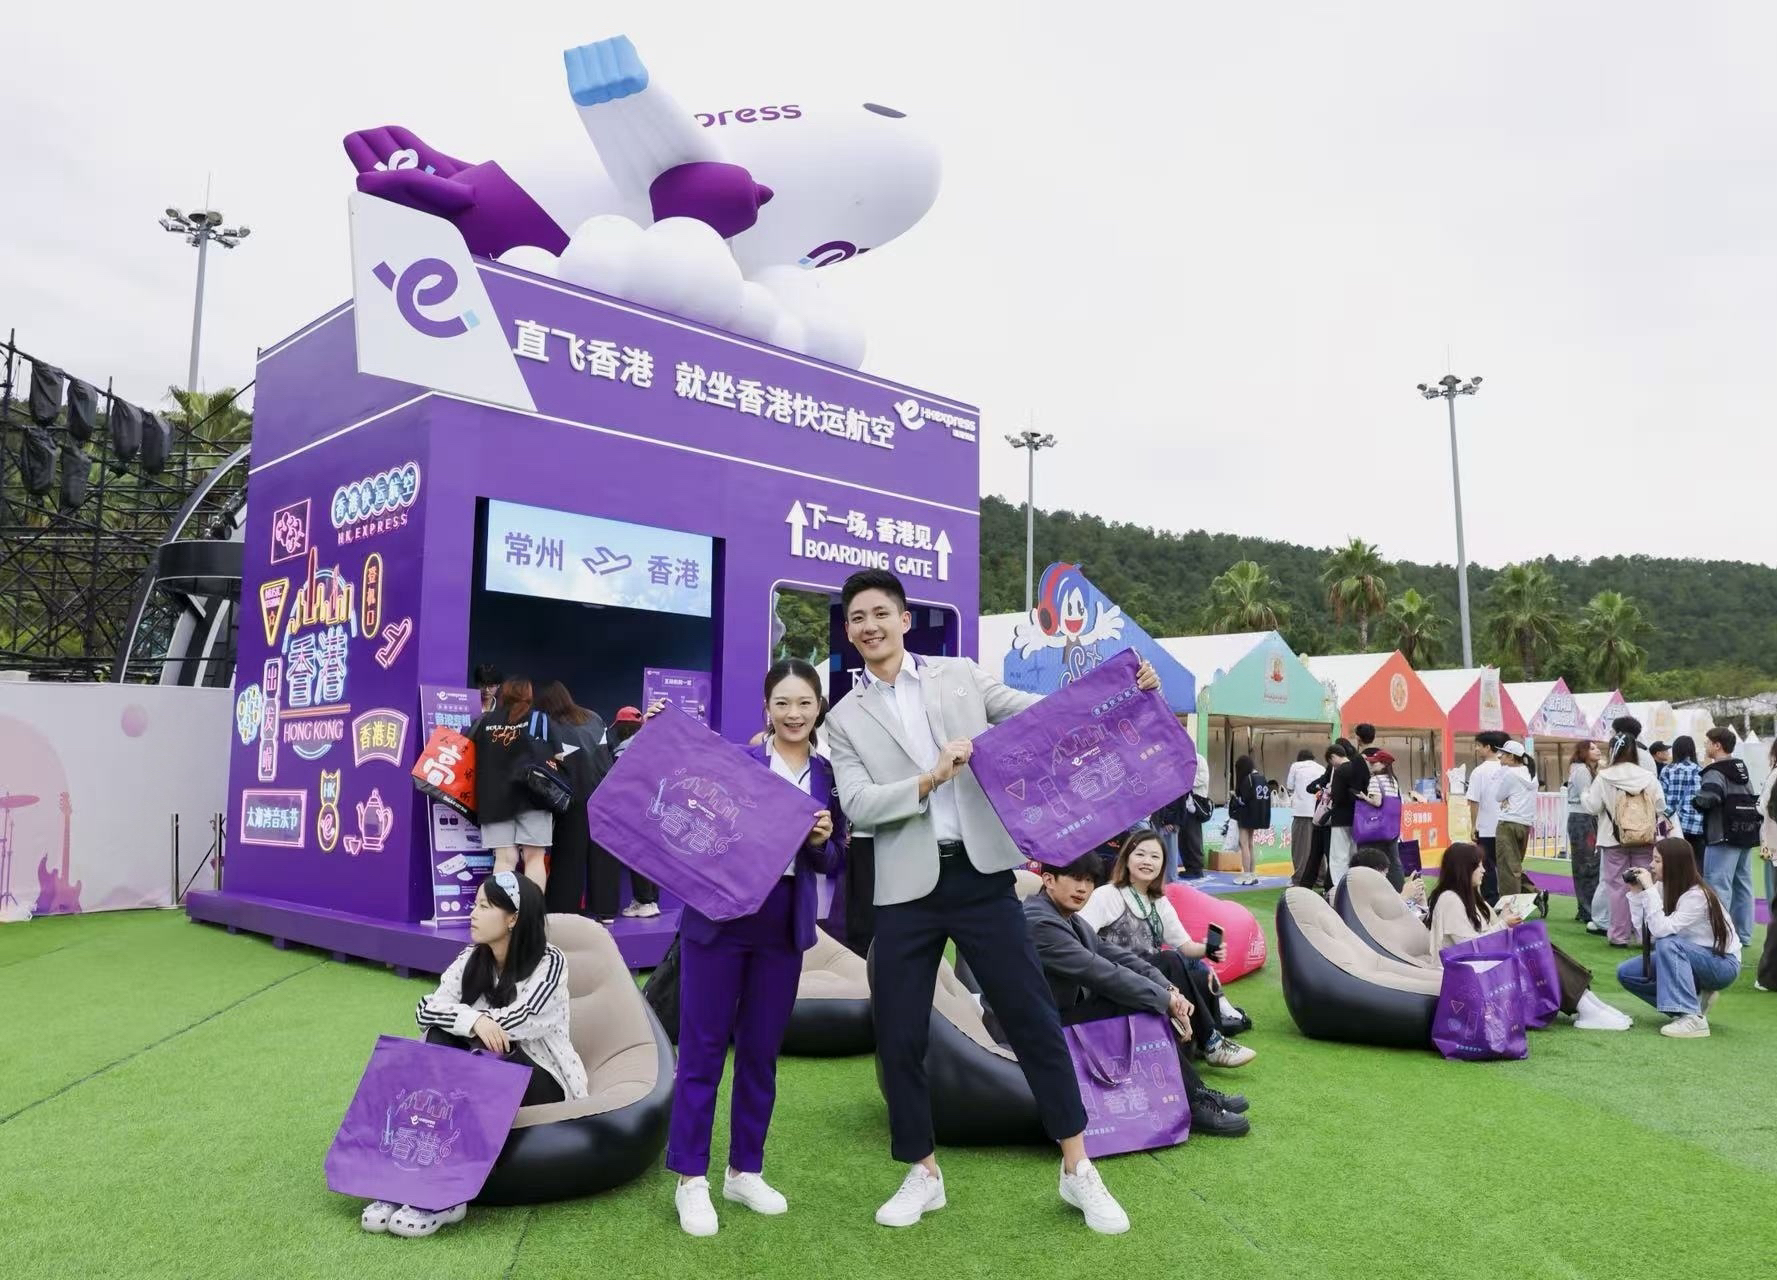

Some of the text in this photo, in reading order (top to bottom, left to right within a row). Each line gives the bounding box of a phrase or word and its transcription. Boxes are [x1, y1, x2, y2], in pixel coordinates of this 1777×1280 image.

[513, 319, 895, 449] 直飞香港 就坐香港快运航空
[355, 513, 408, 539] EXPRESS
[505, 531, 700, 589] 常州 香港
[804, 539, 933, 578] BOARDING GATE
[286, 625, 348, 707] 香港
[283, 719, 344, 743] HONG KONG
[360, 720, 397, 750] 香港見
[322, 781, 337, 798] HK
